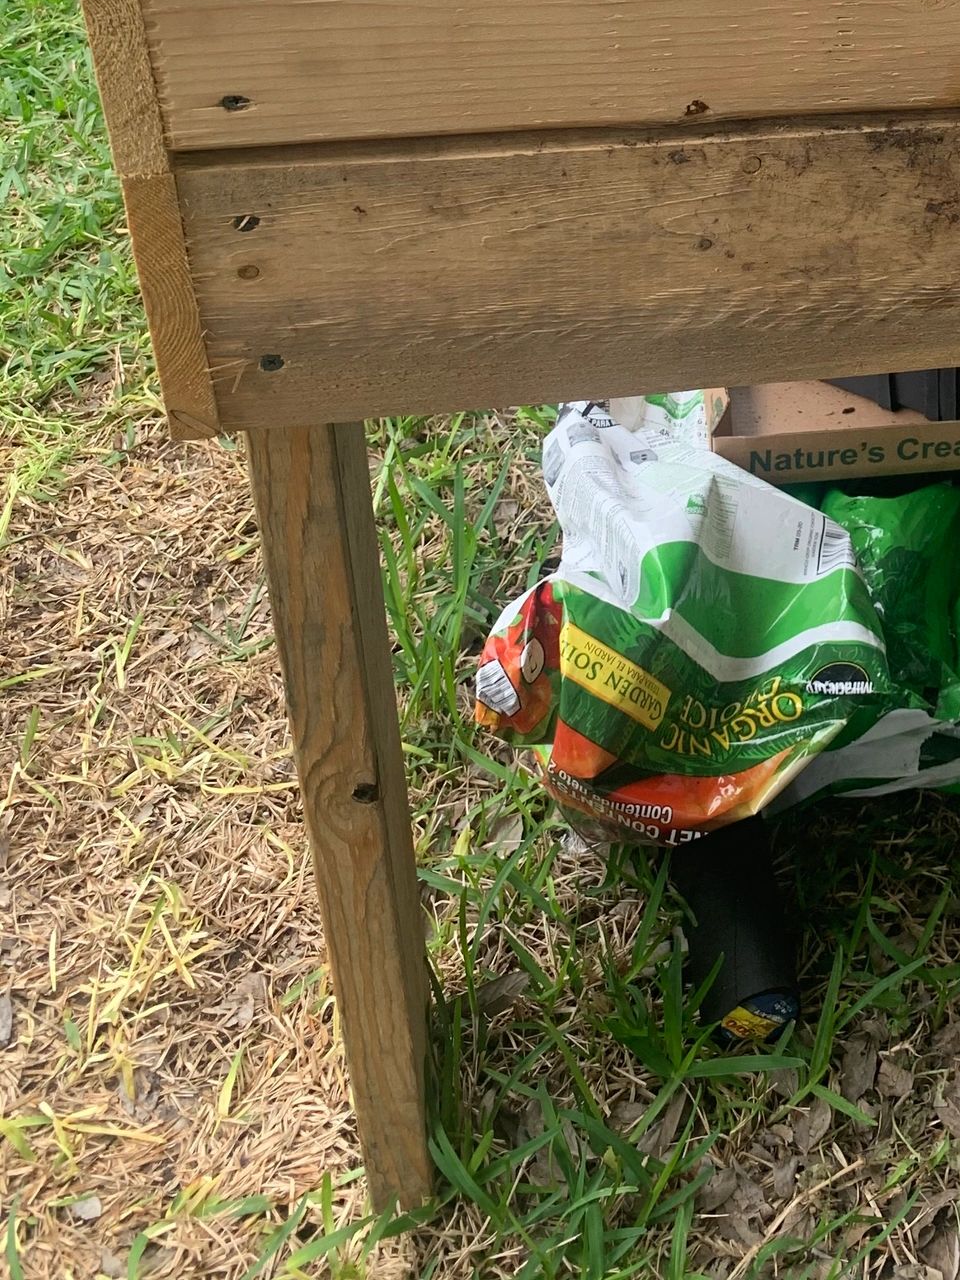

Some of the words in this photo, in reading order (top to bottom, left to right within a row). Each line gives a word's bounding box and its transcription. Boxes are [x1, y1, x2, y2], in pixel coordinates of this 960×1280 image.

[750, 442, 885, 473] Nature's
[616, 663, 626, 671] EL
[603, 671, 662, 721] GARDEN
[661, 692, 803, 756] ORGANIC
[558, 769, 588, 795] neto
[592, 793, 673, 825] Contenido
